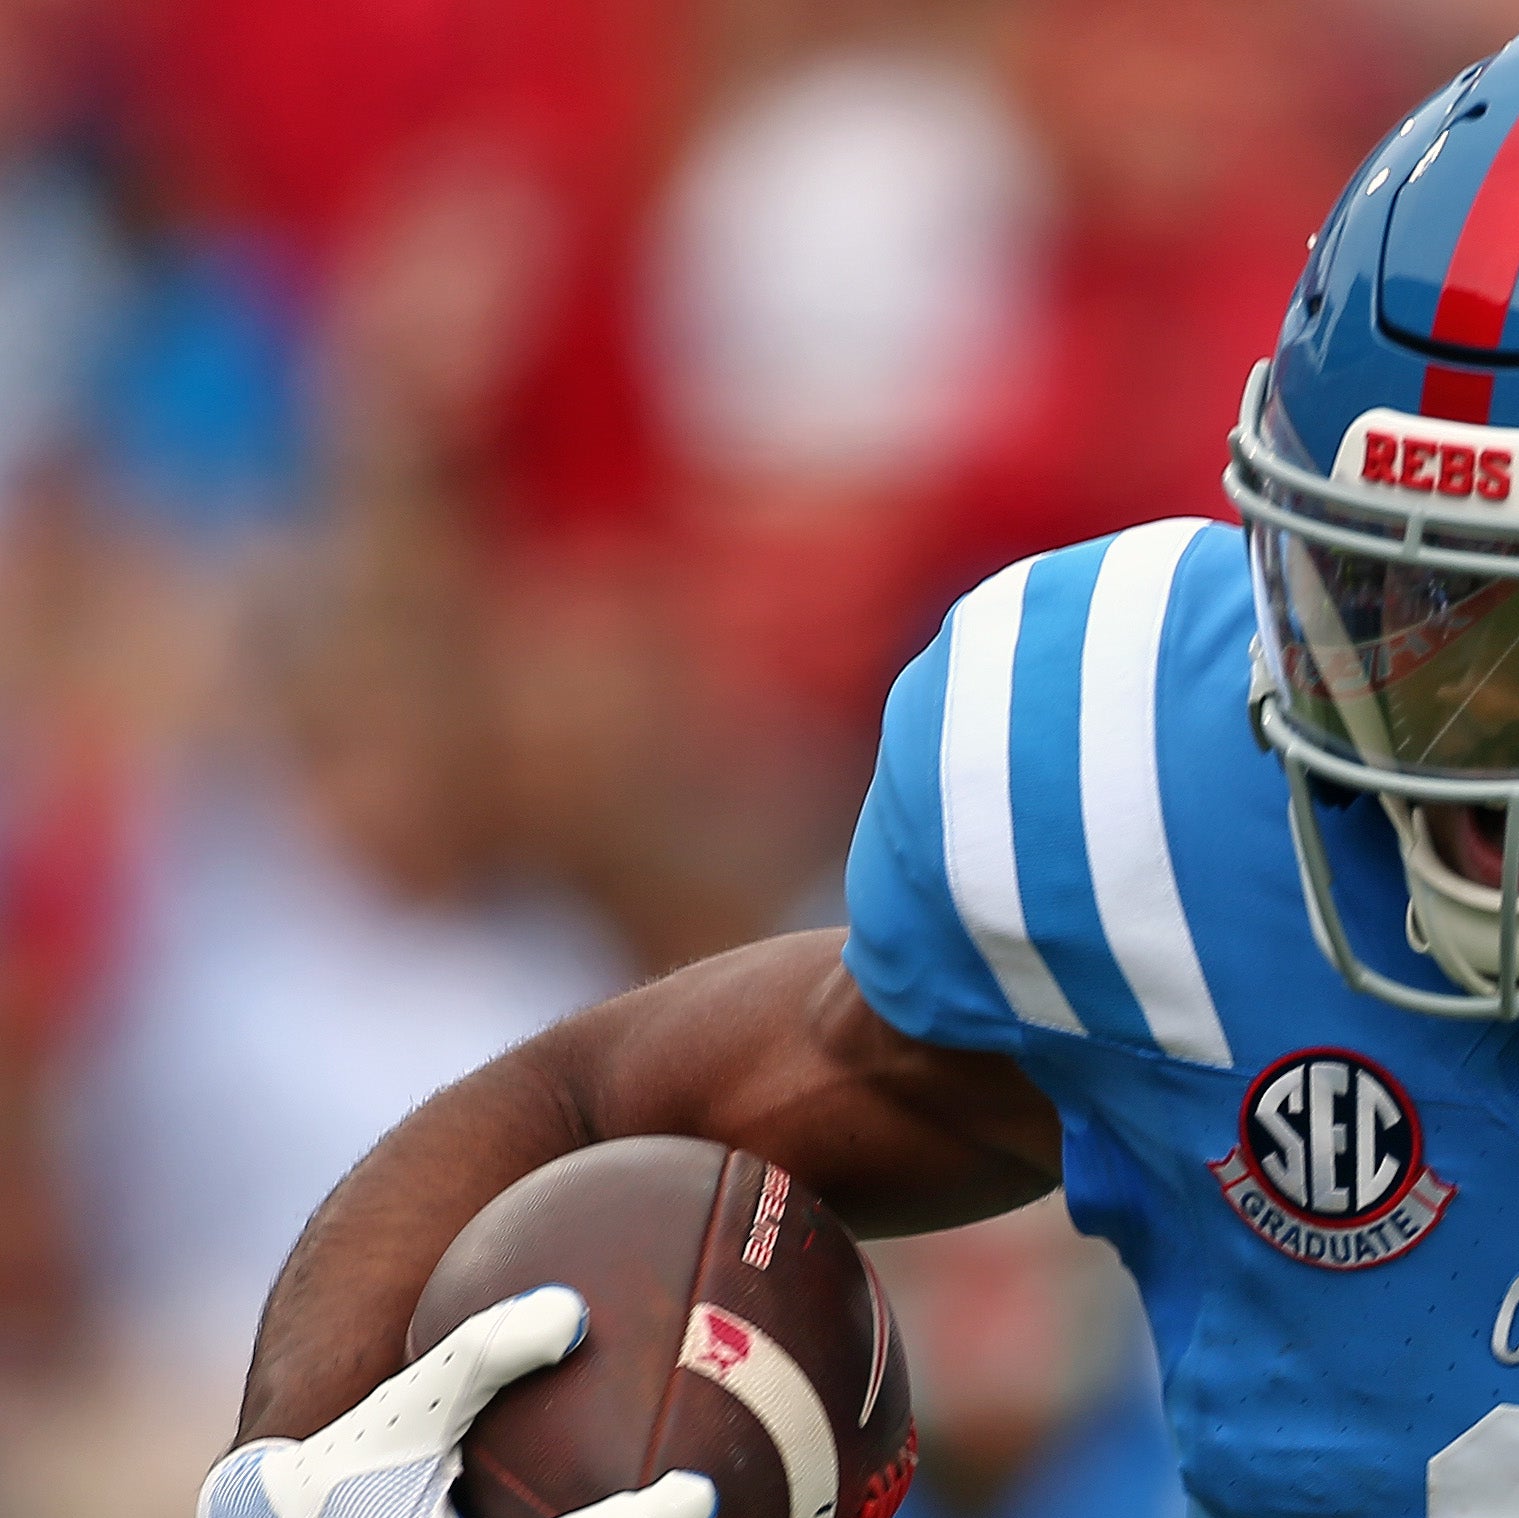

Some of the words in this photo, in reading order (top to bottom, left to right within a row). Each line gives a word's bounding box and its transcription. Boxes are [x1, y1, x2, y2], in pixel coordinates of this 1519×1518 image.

[1361, 428, 1512, 503] REBS
[1255, 1061, 1401, 1214] SEC
[1240, 1190, 1420, 1263] GRADUATE
